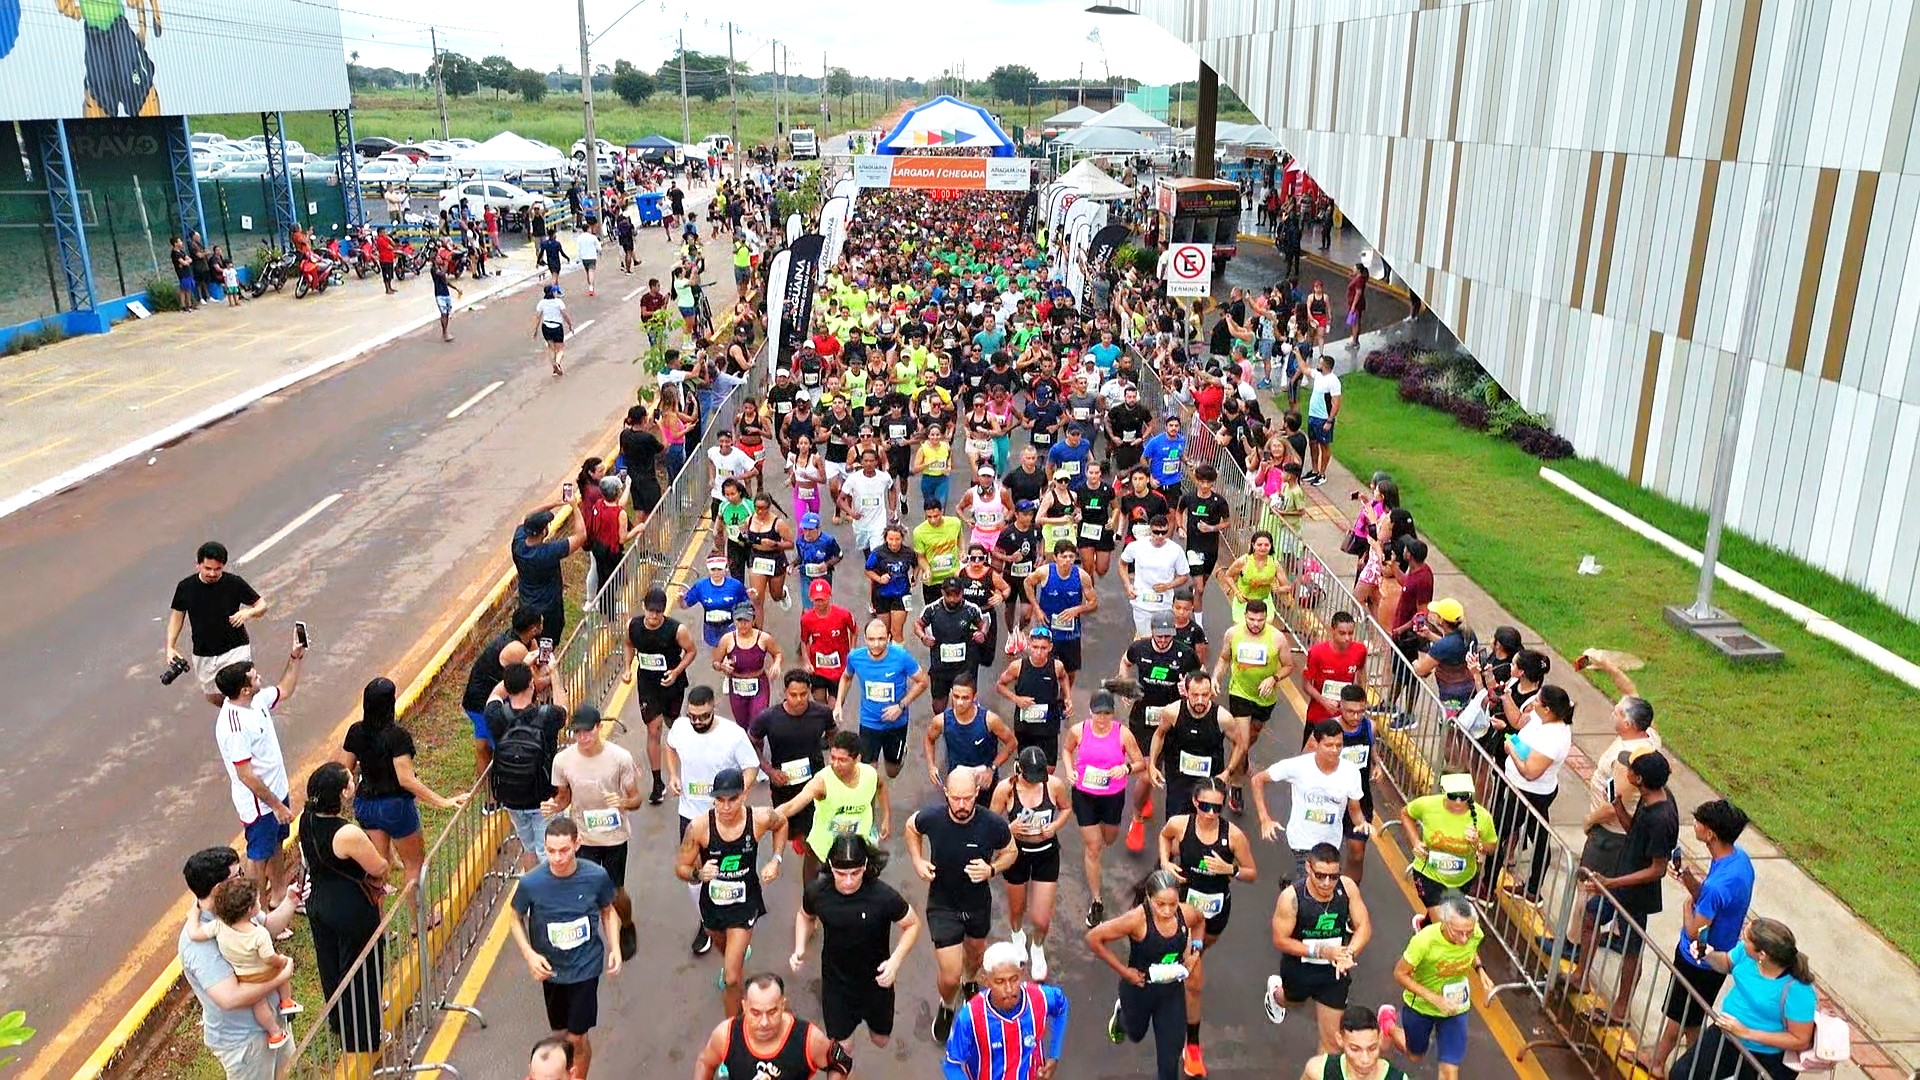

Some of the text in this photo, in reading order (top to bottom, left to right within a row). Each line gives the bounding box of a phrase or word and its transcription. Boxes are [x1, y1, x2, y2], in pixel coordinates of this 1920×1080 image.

[893, 168, 935, 177] LARGADA
[942, 169, 987, 178] CHEGADA
[1184, 254, 1197, 272] E
